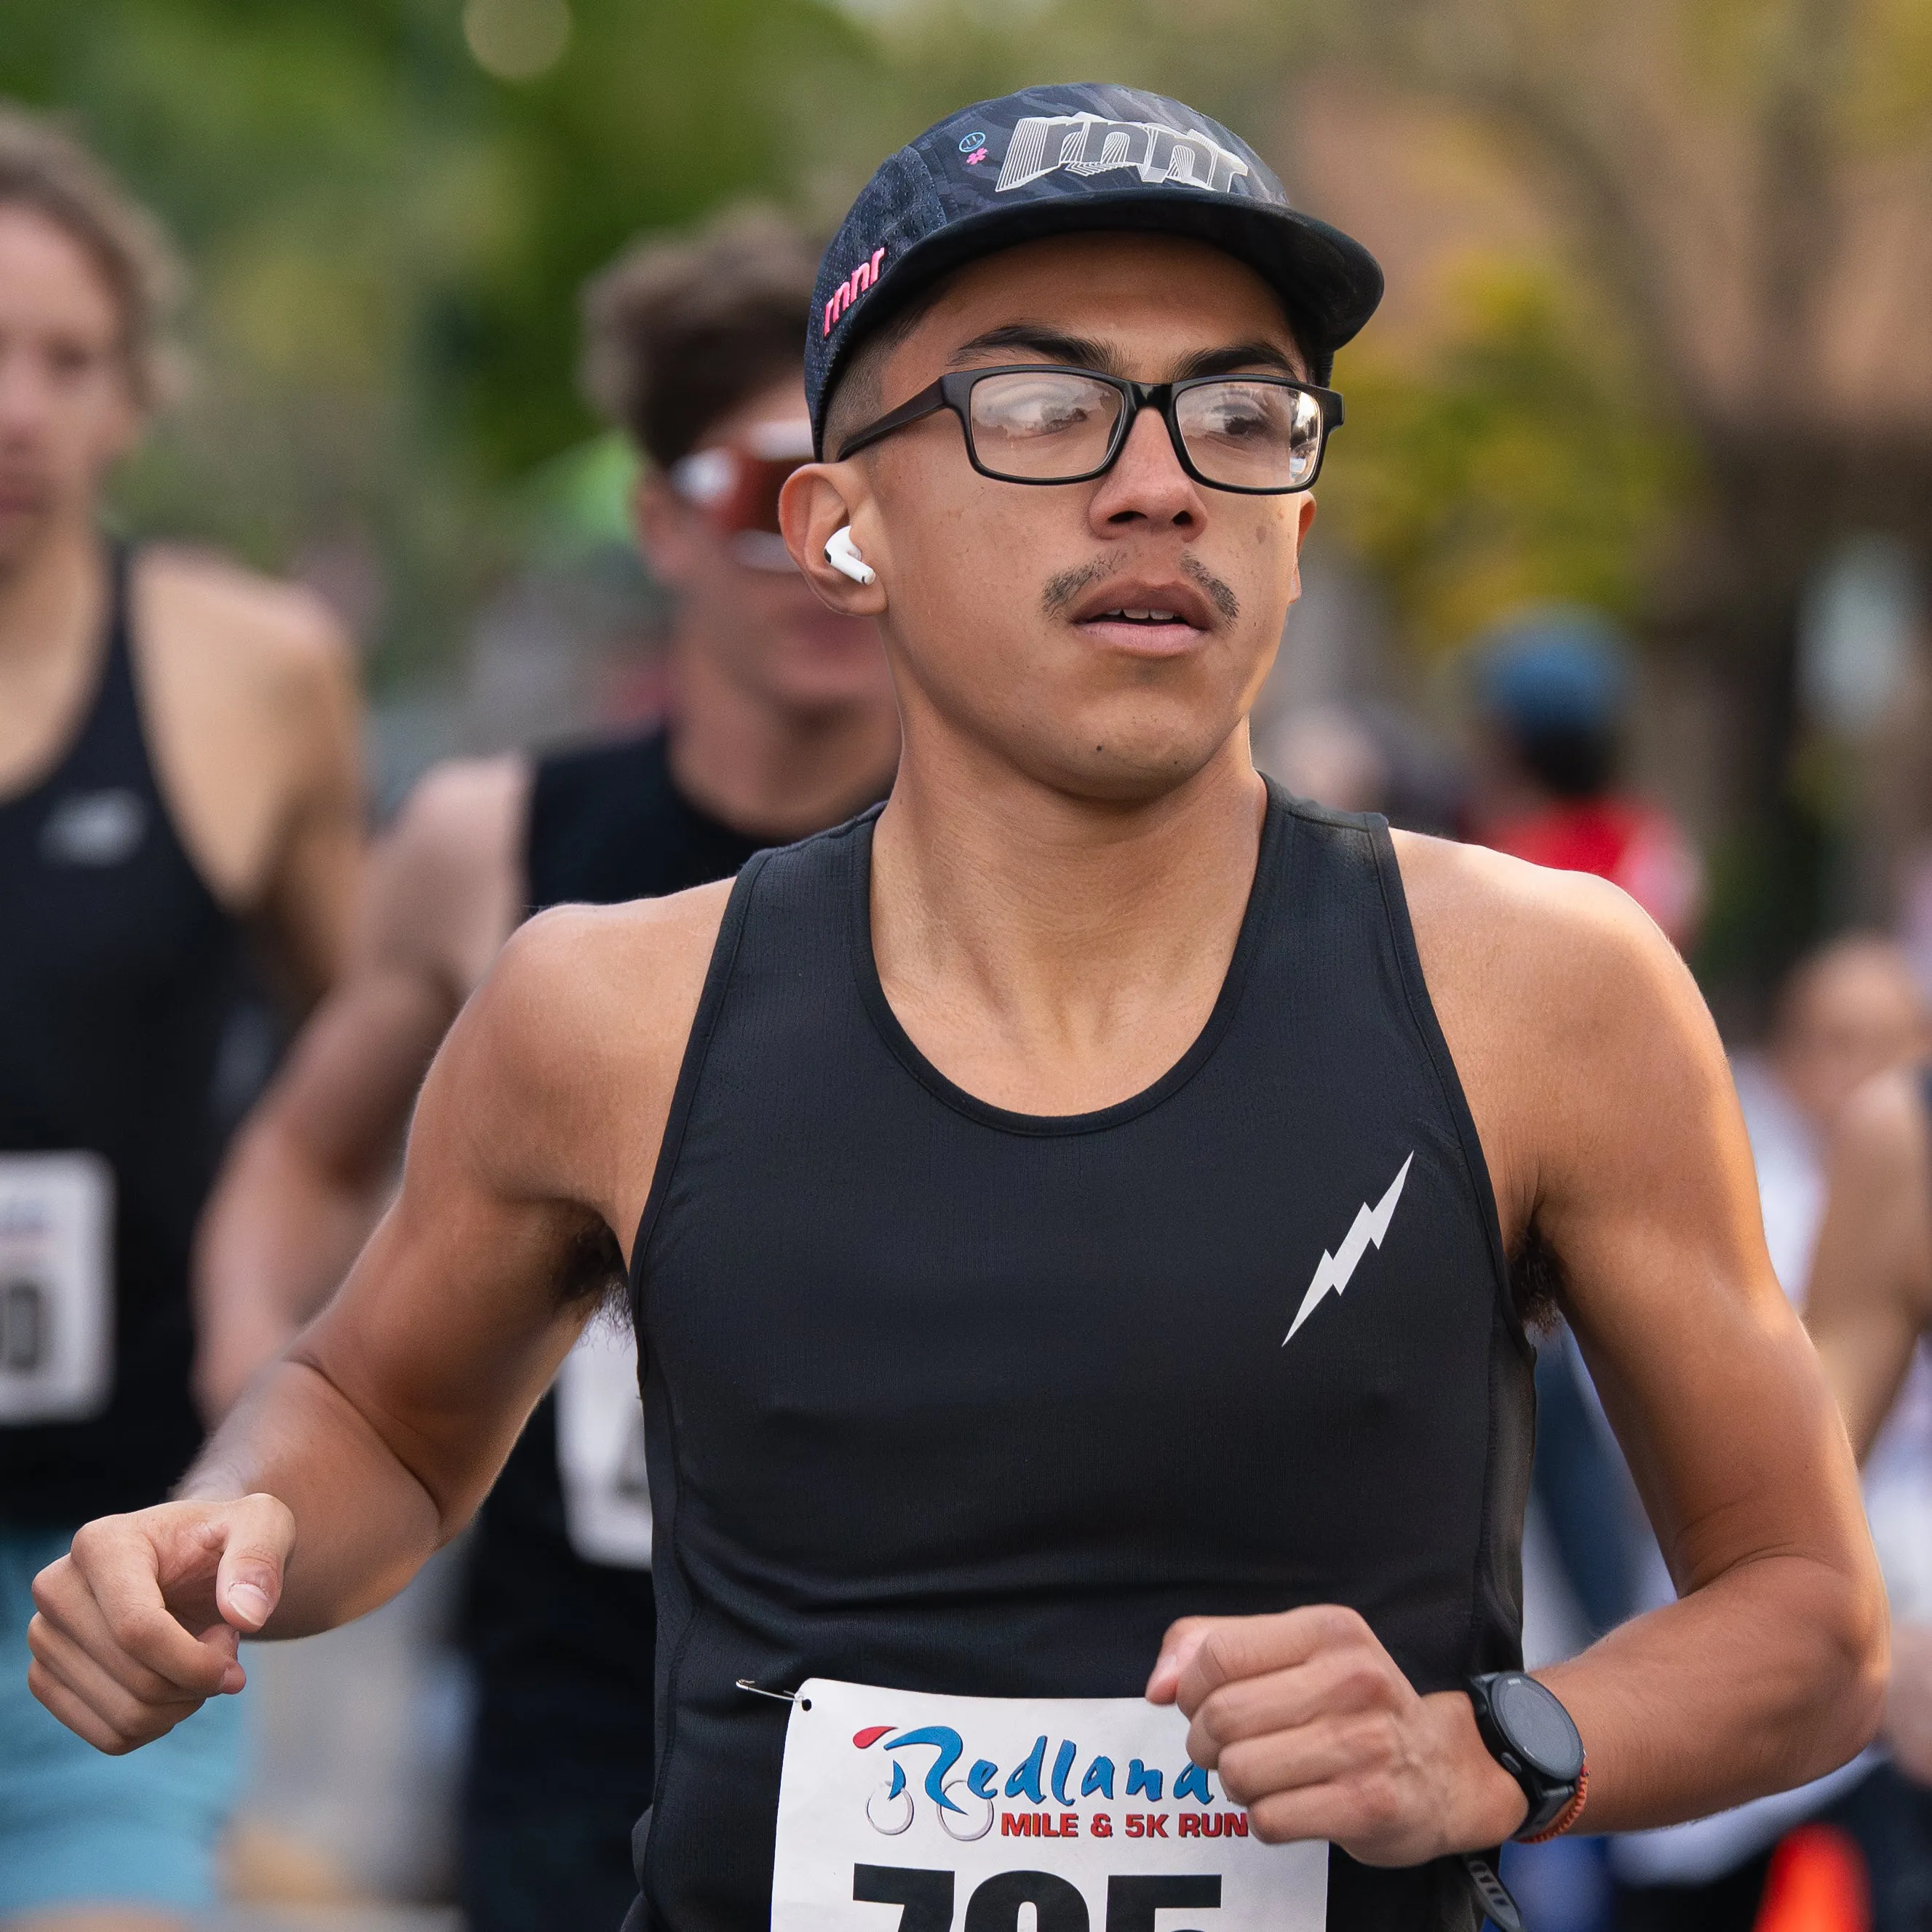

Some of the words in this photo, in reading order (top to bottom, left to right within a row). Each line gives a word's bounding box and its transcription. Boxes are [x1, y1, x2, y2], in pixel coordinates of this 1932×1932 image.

[883, 1725, 1232, 1816] Redland
[1001, 1813, 1078, 1837] MILE
[1090, 1813, 1113, 1837] &
[1125, 1813, 1170, 1838] 5K
[1178, 1813, 1249, 1838] RUN
